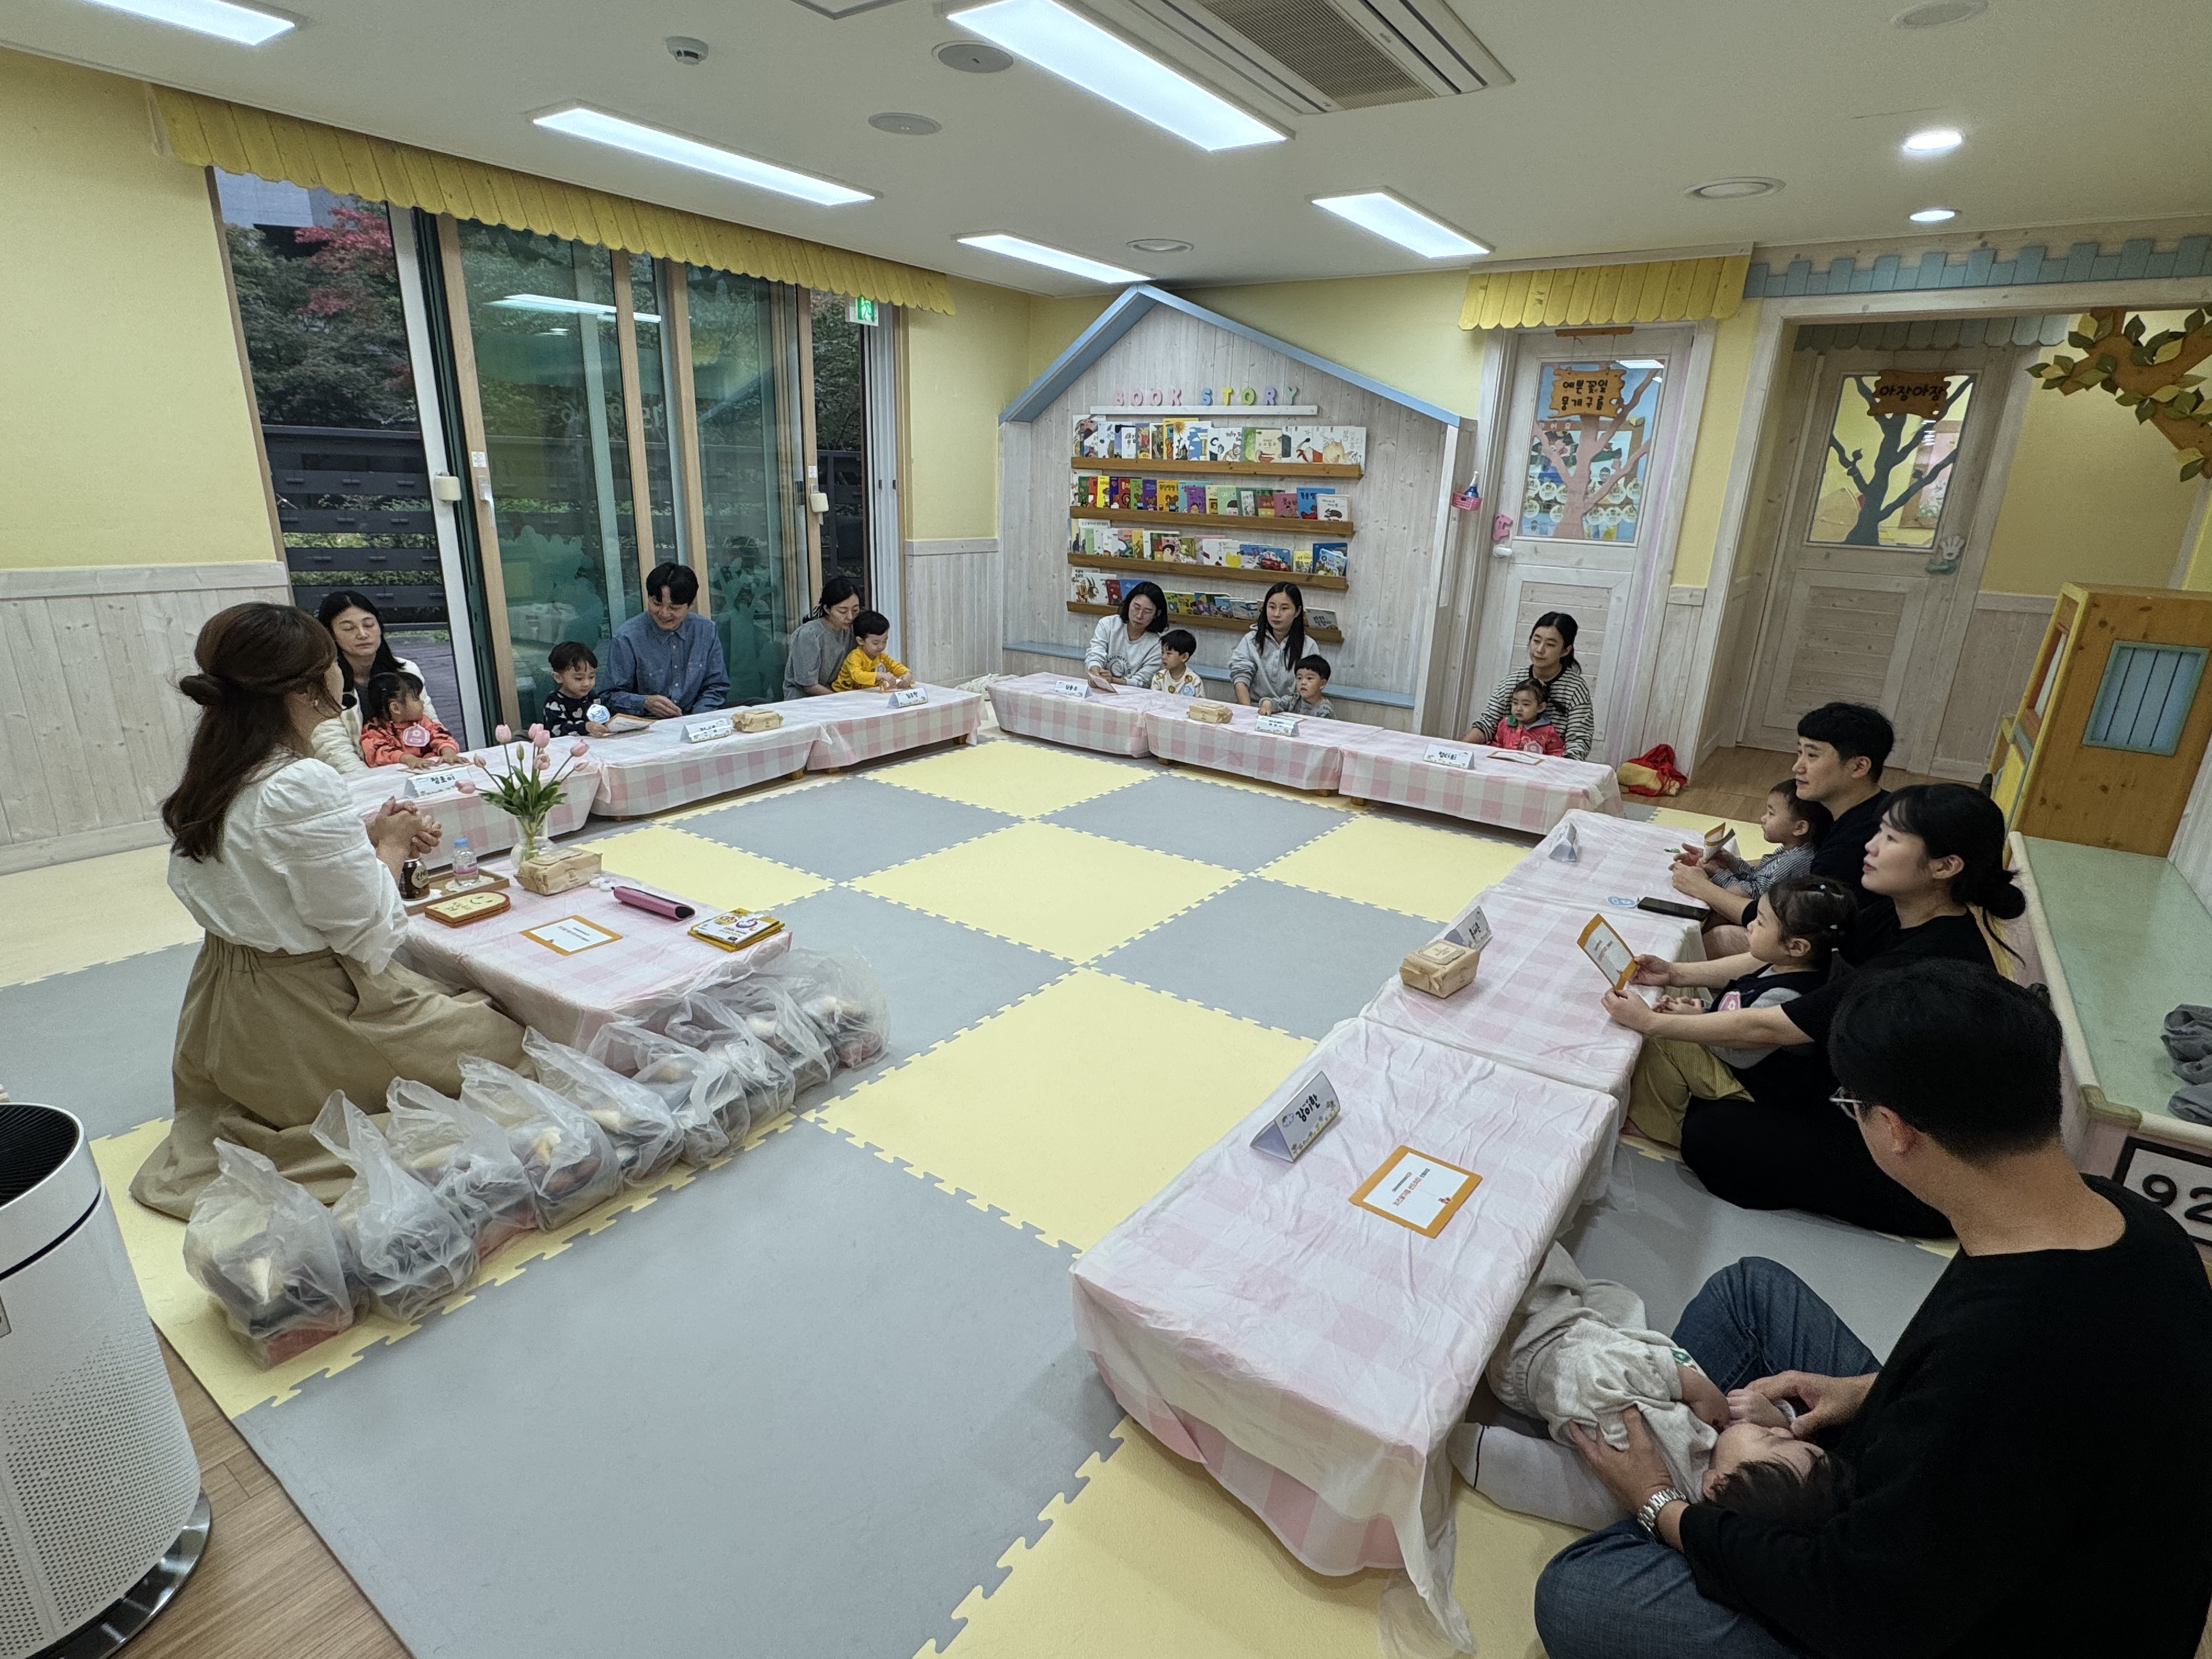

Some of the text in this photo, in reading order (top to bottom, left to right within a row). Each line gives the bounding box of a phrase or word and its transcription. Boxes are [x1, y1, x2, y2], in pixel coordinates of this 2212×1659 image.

[1115, 386, 1299, 406] BOOK STORY
[1878, 384, 1945, 401] 아장아장
[1295, 1093, 1321, 1122] 강이한
[2142, 1173, 2212, 1224] 92
